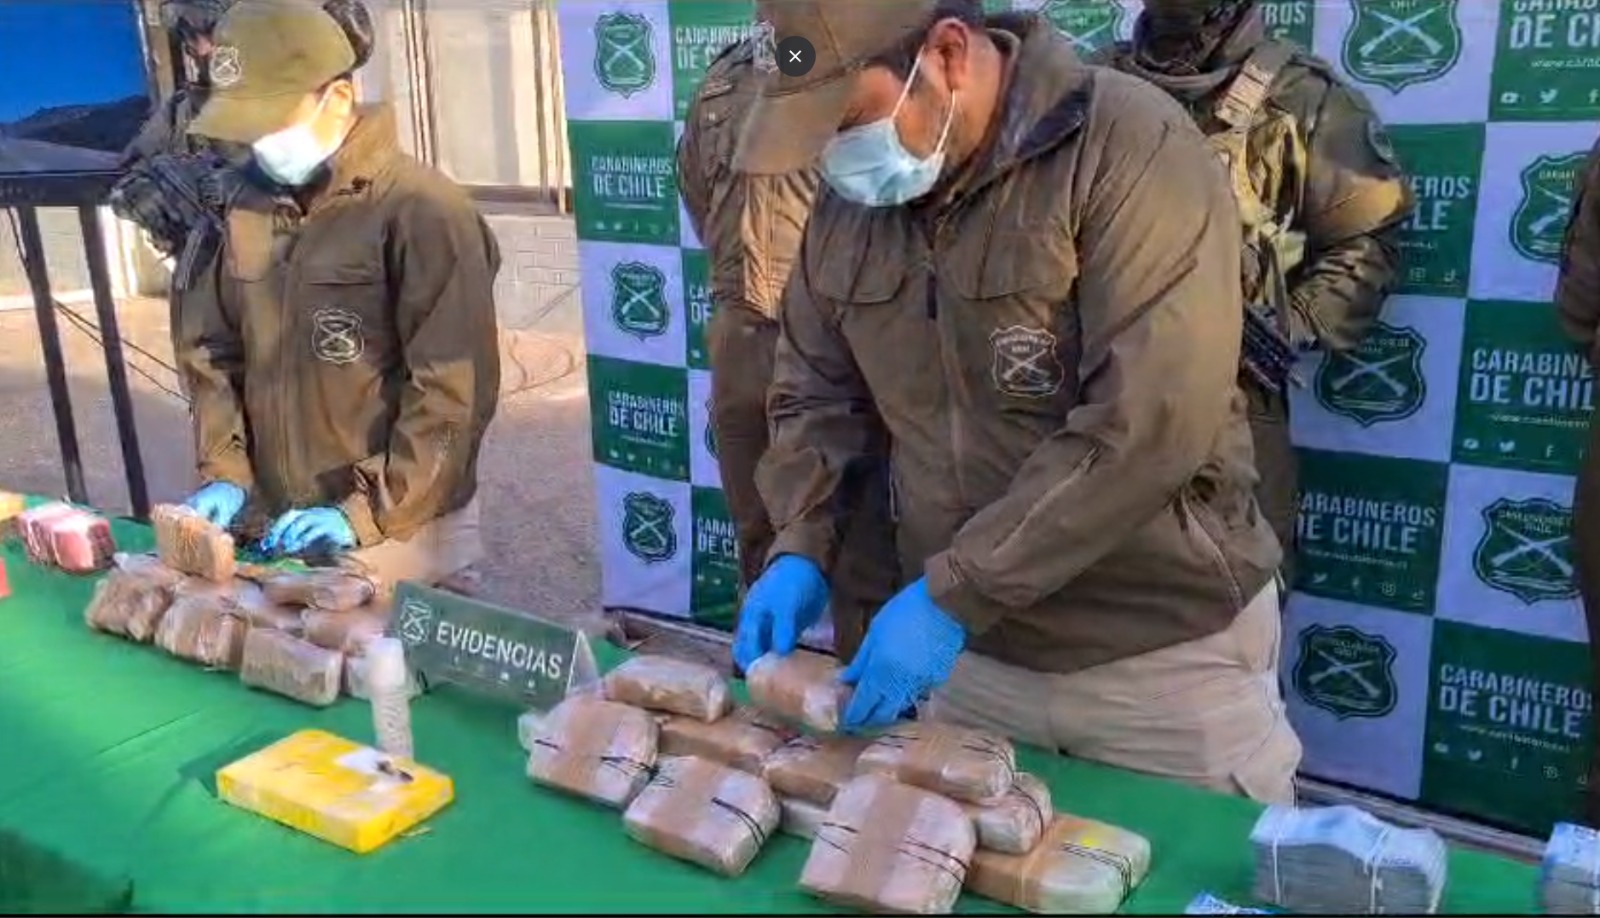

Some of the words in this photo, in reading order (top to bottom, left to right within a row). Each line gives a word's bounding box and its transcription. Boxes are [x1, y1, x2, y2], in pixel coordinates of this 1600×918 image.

[1509, 14, 1556, 49] DE
[677, 45, 700, 69] DE
[593, 173, 613, 197] DE
[618, 175, 666, 198] CHILE
[1469, 373, 1512, 404] DE
[609, 405, 629, 428] DE
[634, 410, 679, 438] CHILE
[1297, 491, 1437, 527] ARABINEROS
[698, 533, 718, 555] DE
[1333, 516, 1418, 554] CHILE
[436, 622, 563, 680] EVIDENCIAS
[1440, 685, 1478, 717] DE
[1489, 694, 1582, 739] CHILE
